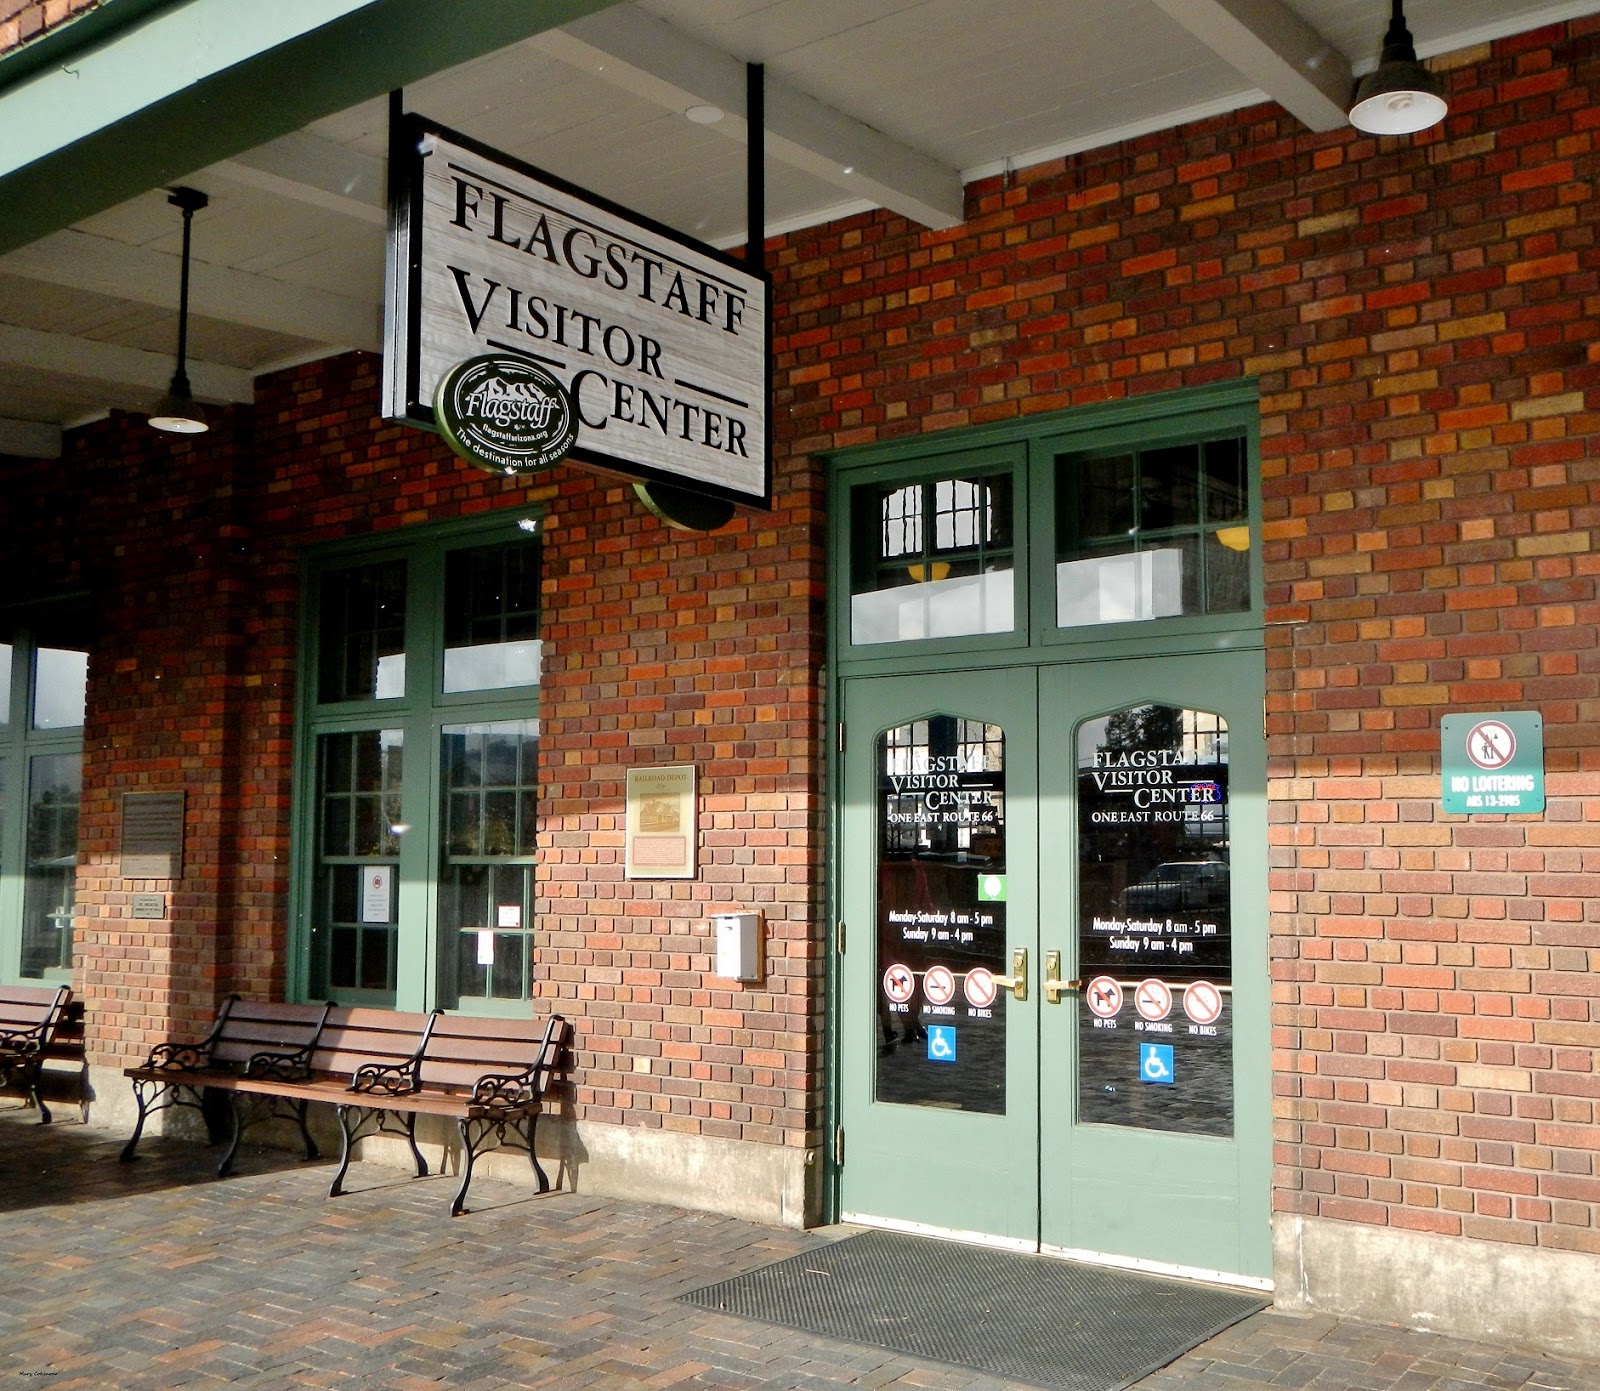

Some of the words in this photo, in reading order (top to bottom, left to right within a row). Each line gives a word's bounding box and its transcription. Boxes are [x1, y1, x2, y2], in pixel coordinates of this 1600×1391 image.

[449, 176, 746, 336] FLAGSTAFF
[446, 265, 663, 380] VISITOR
[465, 391, 558, 429] Flagstaff
[570, 369, 750, 459] CENTER
[482, 423, 549, 443] flagstaffarizona.org
[456, 427, 471, 447] The
[472, 443, 523, 467] destination
[524, 456, 537, 467] for
[538, 453, 549, 465] all
[548, 433, 575, 461] seasons
[890, 774, 959, 794] VISITOR
[1092, 770, 1173, 791] VISITOR
[1451, 775, 1470, 793] NO
[1472, 774, 1535, 793] LOITERING
[926, 790, 993, 810] CENTER
[1134, 787, 1215, 809] CENTER
[890, 812, 912, 823] ONE
[914, 811, 940, 823] EAST
[942, 811, 980, 823] ROUTE
[981, 810, 994, 822] 66
[1091, 811, 1118, 823] ONE
[1120, 811, 1150, 822] EAST
[1154, 810, 1199, 822] ROUTE
[1200, 809, 1215, 822] 66
[889, 910, 948, 926] Monday-Saturday
[950, 911, 956, 924] 8
[957, 915, 969, 924] am
[974, 912, 980, 924] 5
[981, 914, 993, 927] pm
[1092, 917, 1164, 936] Monday-Saturday
[1165, 919, 1173, 931] 8
[1173, 922, 1187, 933] am
[1194, 920, 1201, 934] 5
[1202, 922, 1217, 937] pm
[903, 927, 928, 942] Sunday
[931, 928, 937, 940] 9
[937, 930, 949, 941] am
[954, 929, 961, 941] 4
[961, 931, 974, 943] pm
[1109, 936, 1140, 953] Sunday
[1143, 937, 1150, 949] 9
[1150, 939, 1165, 951] am
[1170, 938, 1177, 952] 4
[1178, 940, 1193, 954] pm
[889, 1003, 897, 1012] NO
[897, 1003, 909, 1013] PETS
[923, 1005, 931, 1014] NO
[932, 1005, 956, 1016] SMOKING
[968, 1008, 976, 1017] NO
[977, 1008, 992, 1018] BIKES
[1093, 1018, 1103, 1028] NO
[1103, 1019, 1117, 1029] PETS
[1134, 1021, 1144, 1031] NO
[1144, 1022, 1173, 1033] SMOKING
[1188, 1025, 1198, 1035] NO
[1199, 1026, 1217, 1036] BIKES
